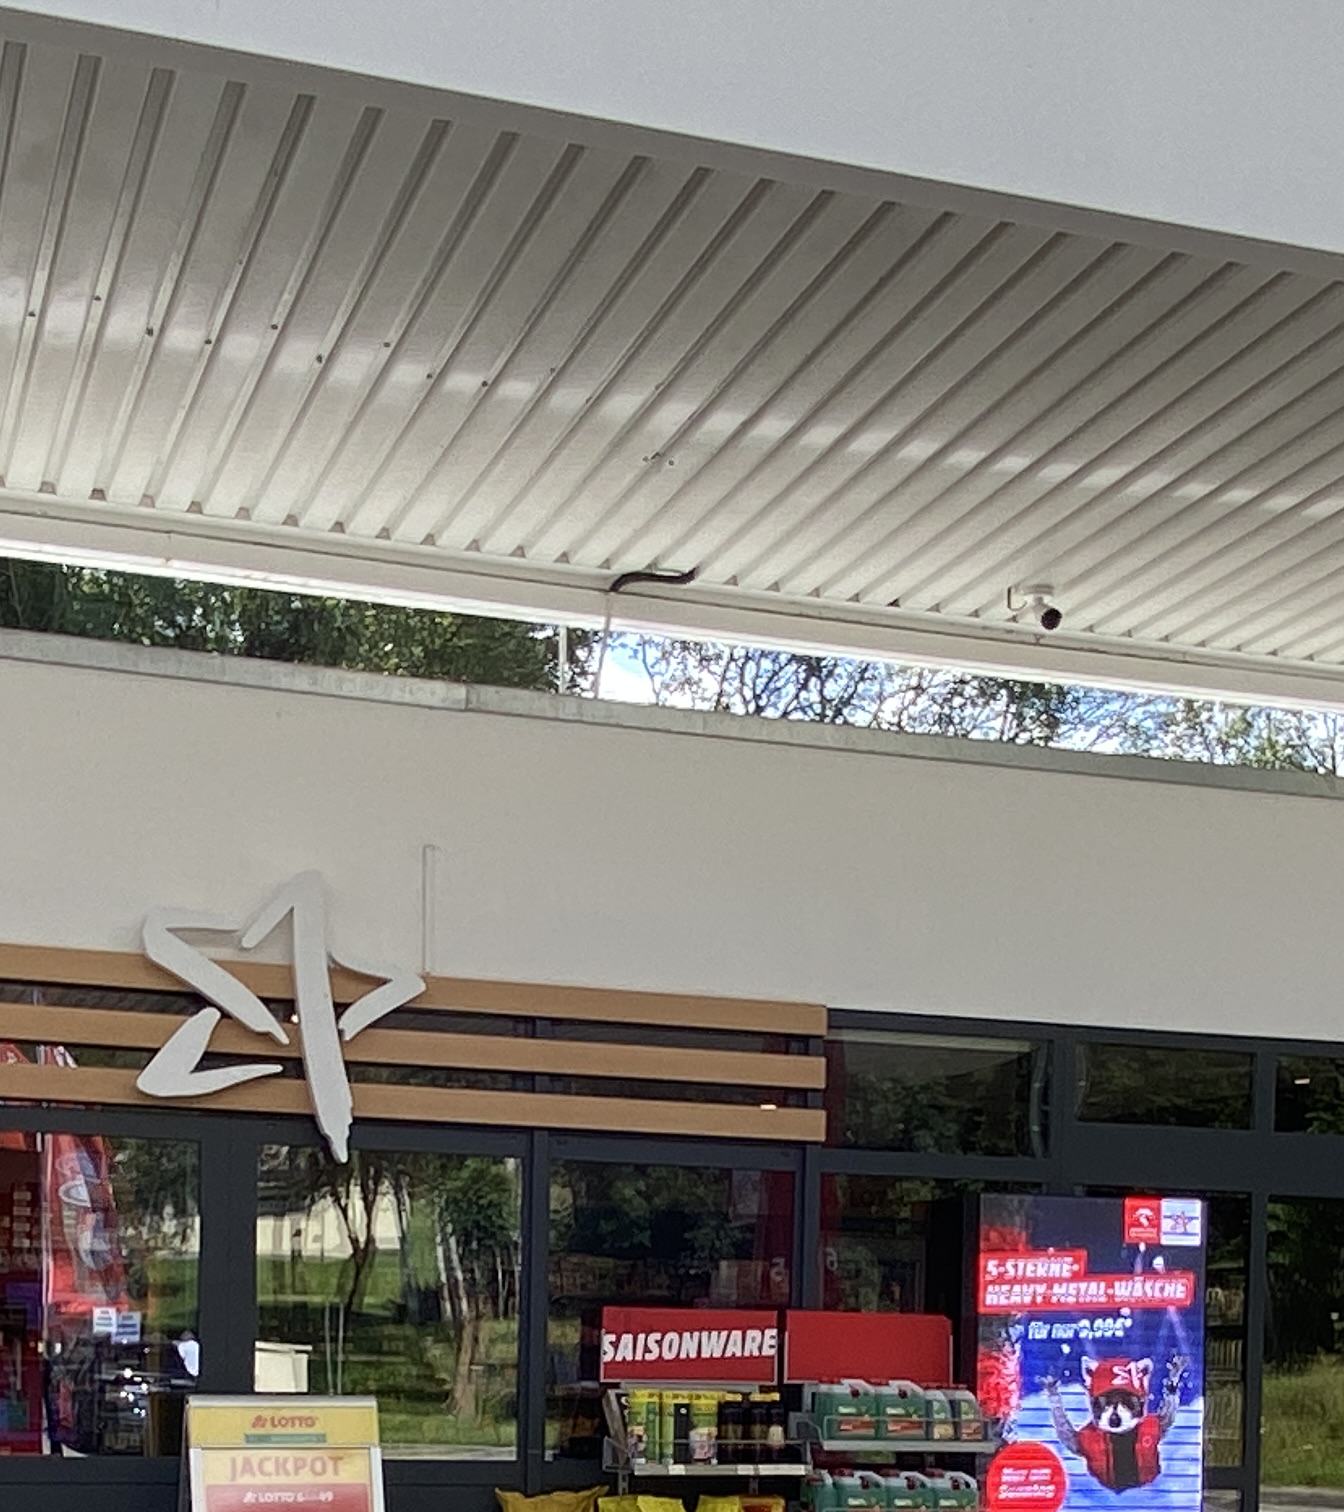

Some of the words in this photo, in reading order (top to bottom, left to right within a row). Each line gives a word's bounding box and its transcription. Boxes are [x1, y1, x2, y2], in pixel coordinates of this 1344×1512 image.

[601, 1327, 778, 1363] SAISONWARE
[271, 1415, 317, 1428] LOTTO
[230, 1456, 343, 1481] JACKPOT
[258, 1491, 295, 1503] LOTTO
